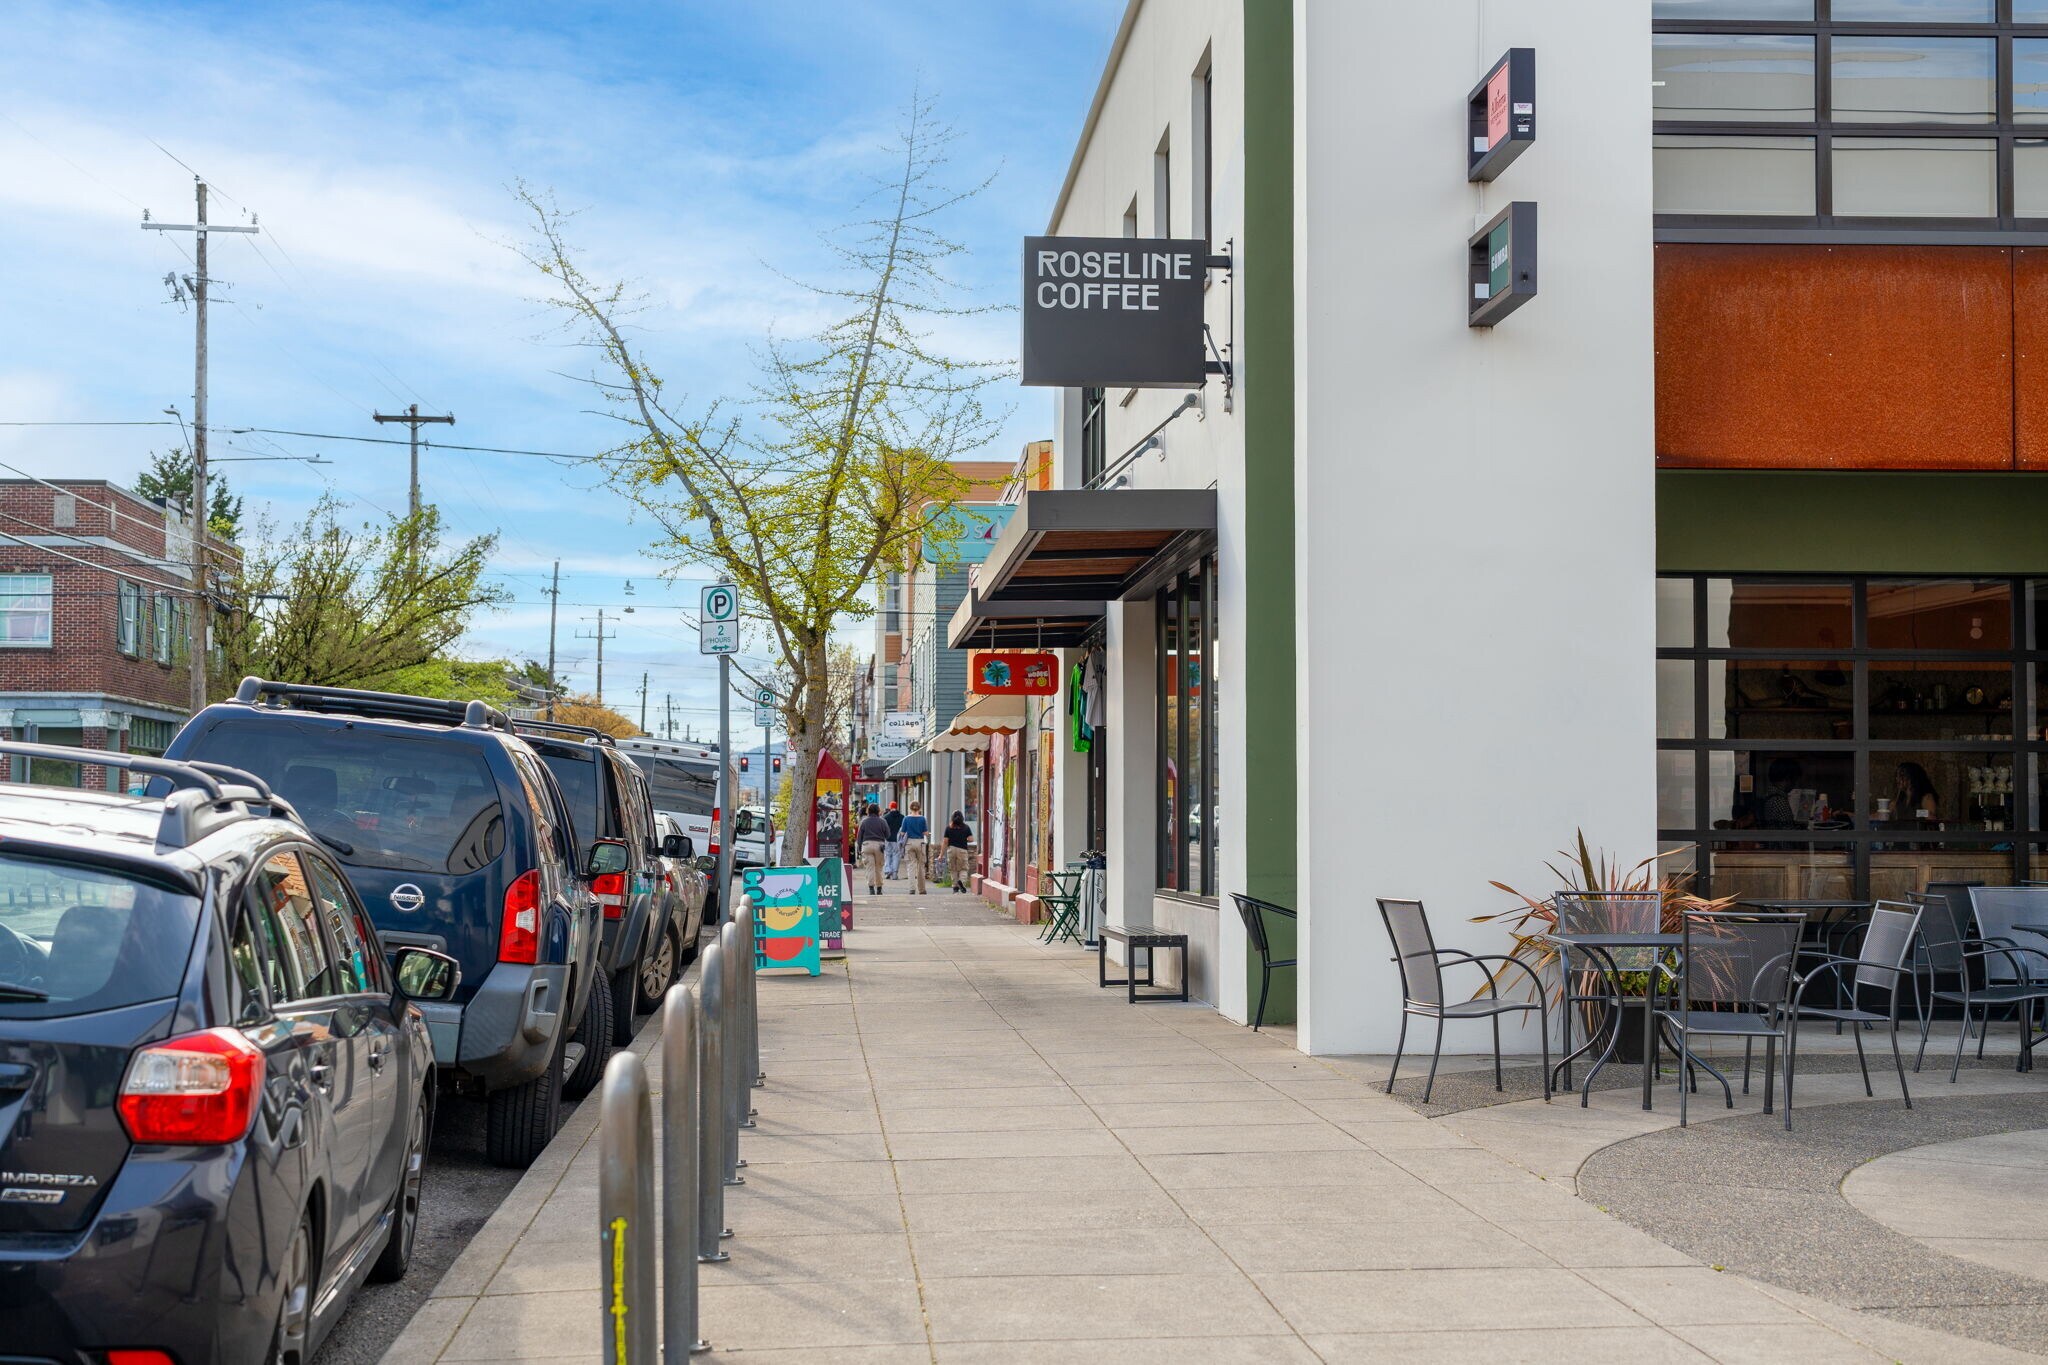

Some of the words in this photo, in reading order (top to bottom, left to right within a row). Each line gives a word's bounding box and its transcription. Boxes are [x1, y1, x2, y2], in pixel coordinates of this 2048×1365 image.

[1038, 250, 1192, 280] ROSELINE
[1037, 281, 1160, 311] COFFEE
[715, 594, 727, 614] P
[717, 625, 724, 636] 2
[888, 719, 920, 728] collage
[393, 894, 422, 902] NISSAN
[2, 1171, 98, 1186] IMPREZA
[4, 1190, 60, 1201] SPORT
